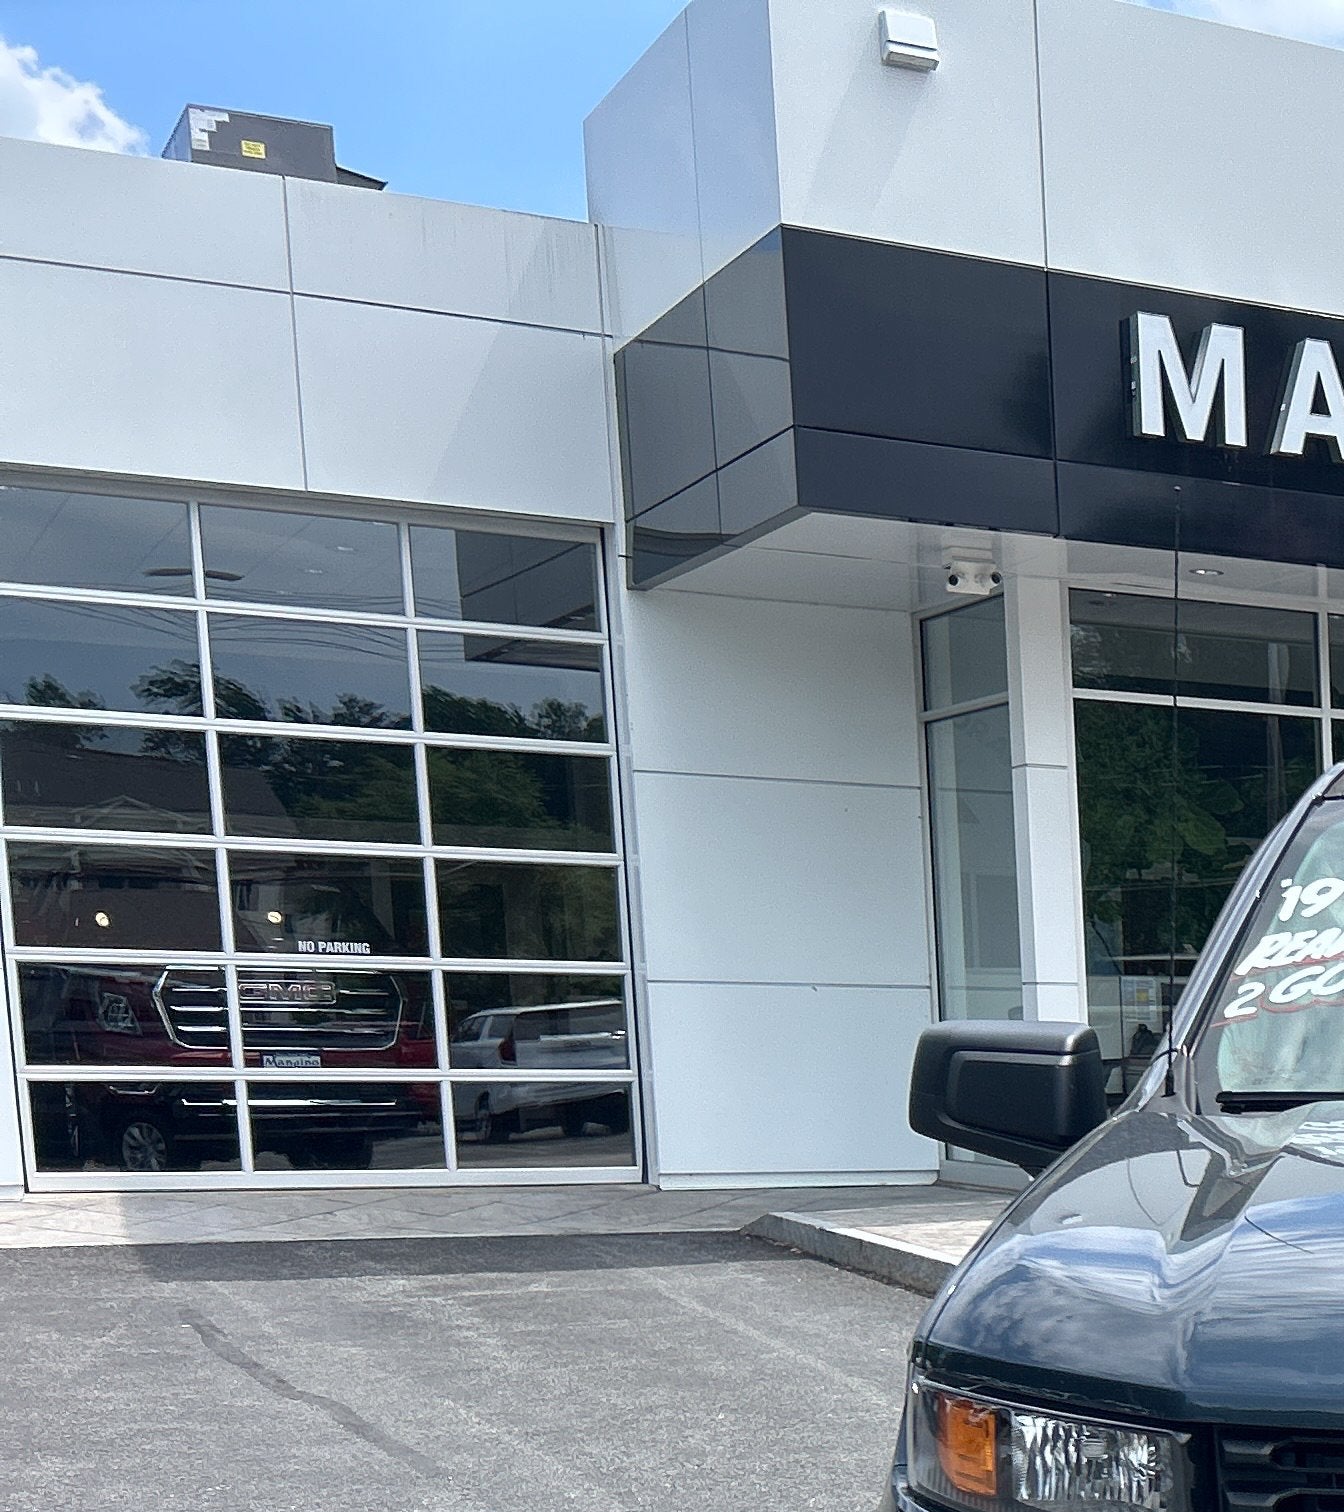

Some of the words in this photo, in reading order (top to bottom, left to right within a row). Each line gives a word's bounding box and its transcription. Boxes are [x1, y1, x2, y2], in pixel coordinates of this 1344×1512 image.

[298, 941, 314, 953] NO
[318, 941, 371, 954] PARKING
[1223, 981, 1266, 1019] 2
